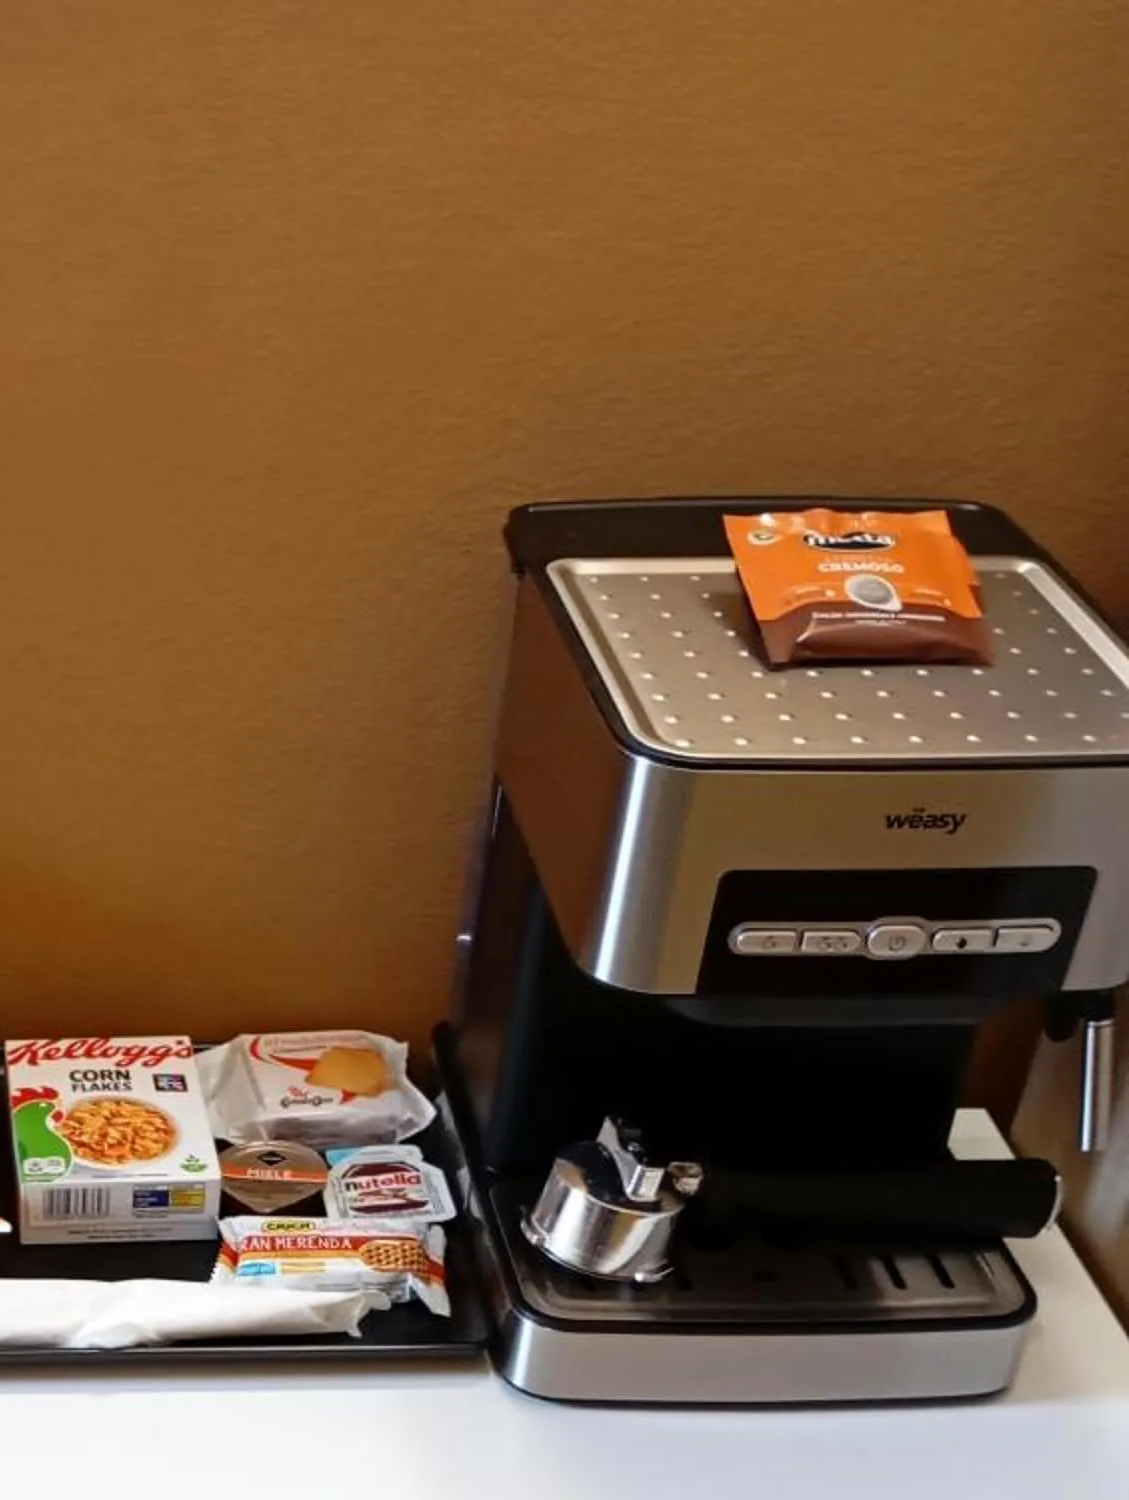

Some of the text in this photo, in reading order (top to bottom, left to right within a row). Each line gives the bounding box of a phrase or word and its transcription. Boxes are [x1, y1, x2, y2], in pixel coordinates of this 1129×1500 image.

[7, 1037, 193, 1067] Kellogg's
[69, 1069, 131, 1083] CORN
[71, 1082, 133, 1093] FLAKES
[345, 1171, 423, 1192] nutella
[273, 1235, 352, 1250] MERENDA
